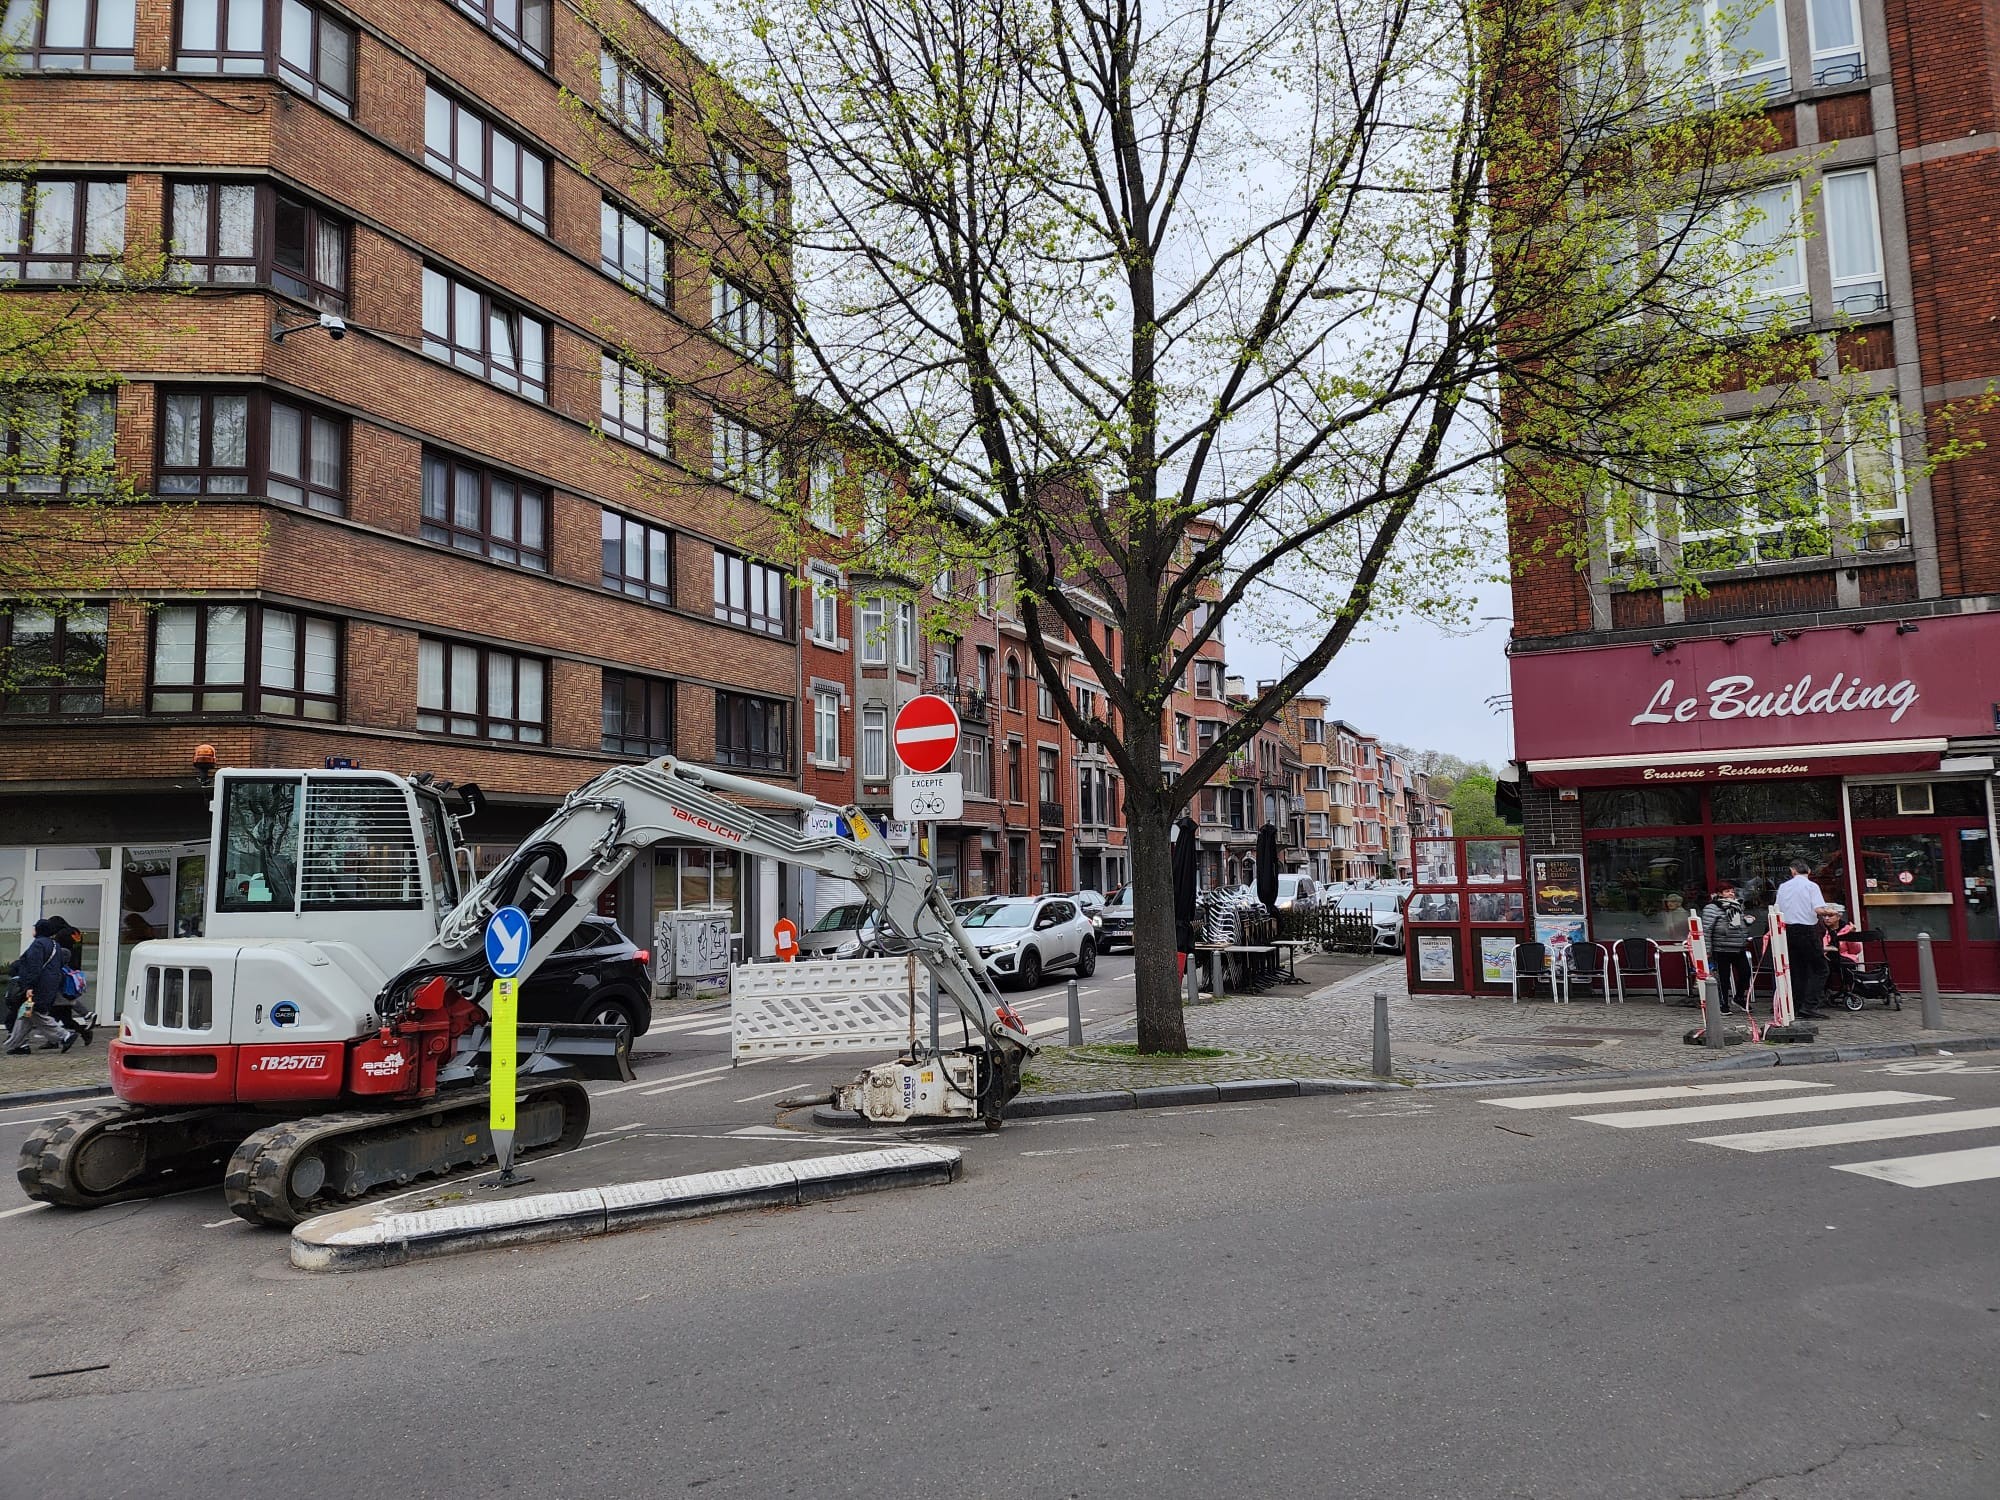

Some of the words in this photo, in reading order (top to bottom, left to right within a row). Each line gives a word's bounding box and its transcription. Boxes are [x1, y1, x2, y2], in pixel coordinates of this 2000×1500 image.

[1630, 679, 1698, 725] Le
[1706, 672, 1920, 724] Building
[1643, 768, 1706, 780] Brasserie
[1718, 764, 1809, 777] Restauration
[811, 816, 829, 831] Lyca
[903, 1076, 912, 1110] DB30V
